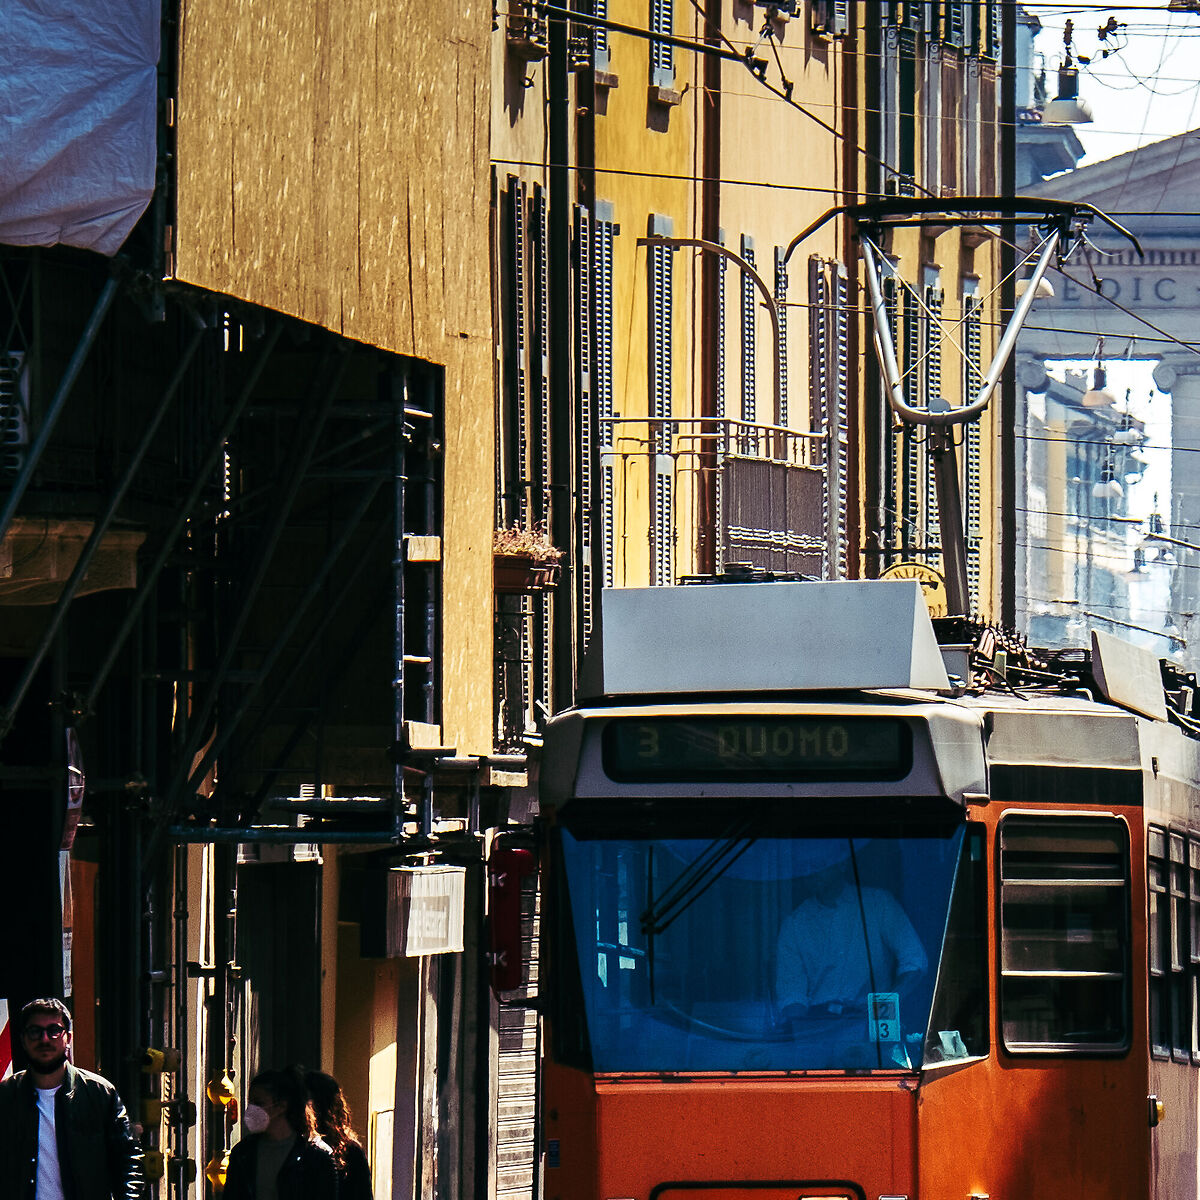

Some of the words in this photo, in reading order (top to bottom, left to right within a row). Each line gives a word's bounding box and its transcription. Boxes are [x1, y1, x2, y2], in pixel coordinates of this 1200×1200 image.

[637, 726, 660, 758] 3
[718, 725, 849, 758] DUOMO
[880, 1022, 890, 1038] 3
